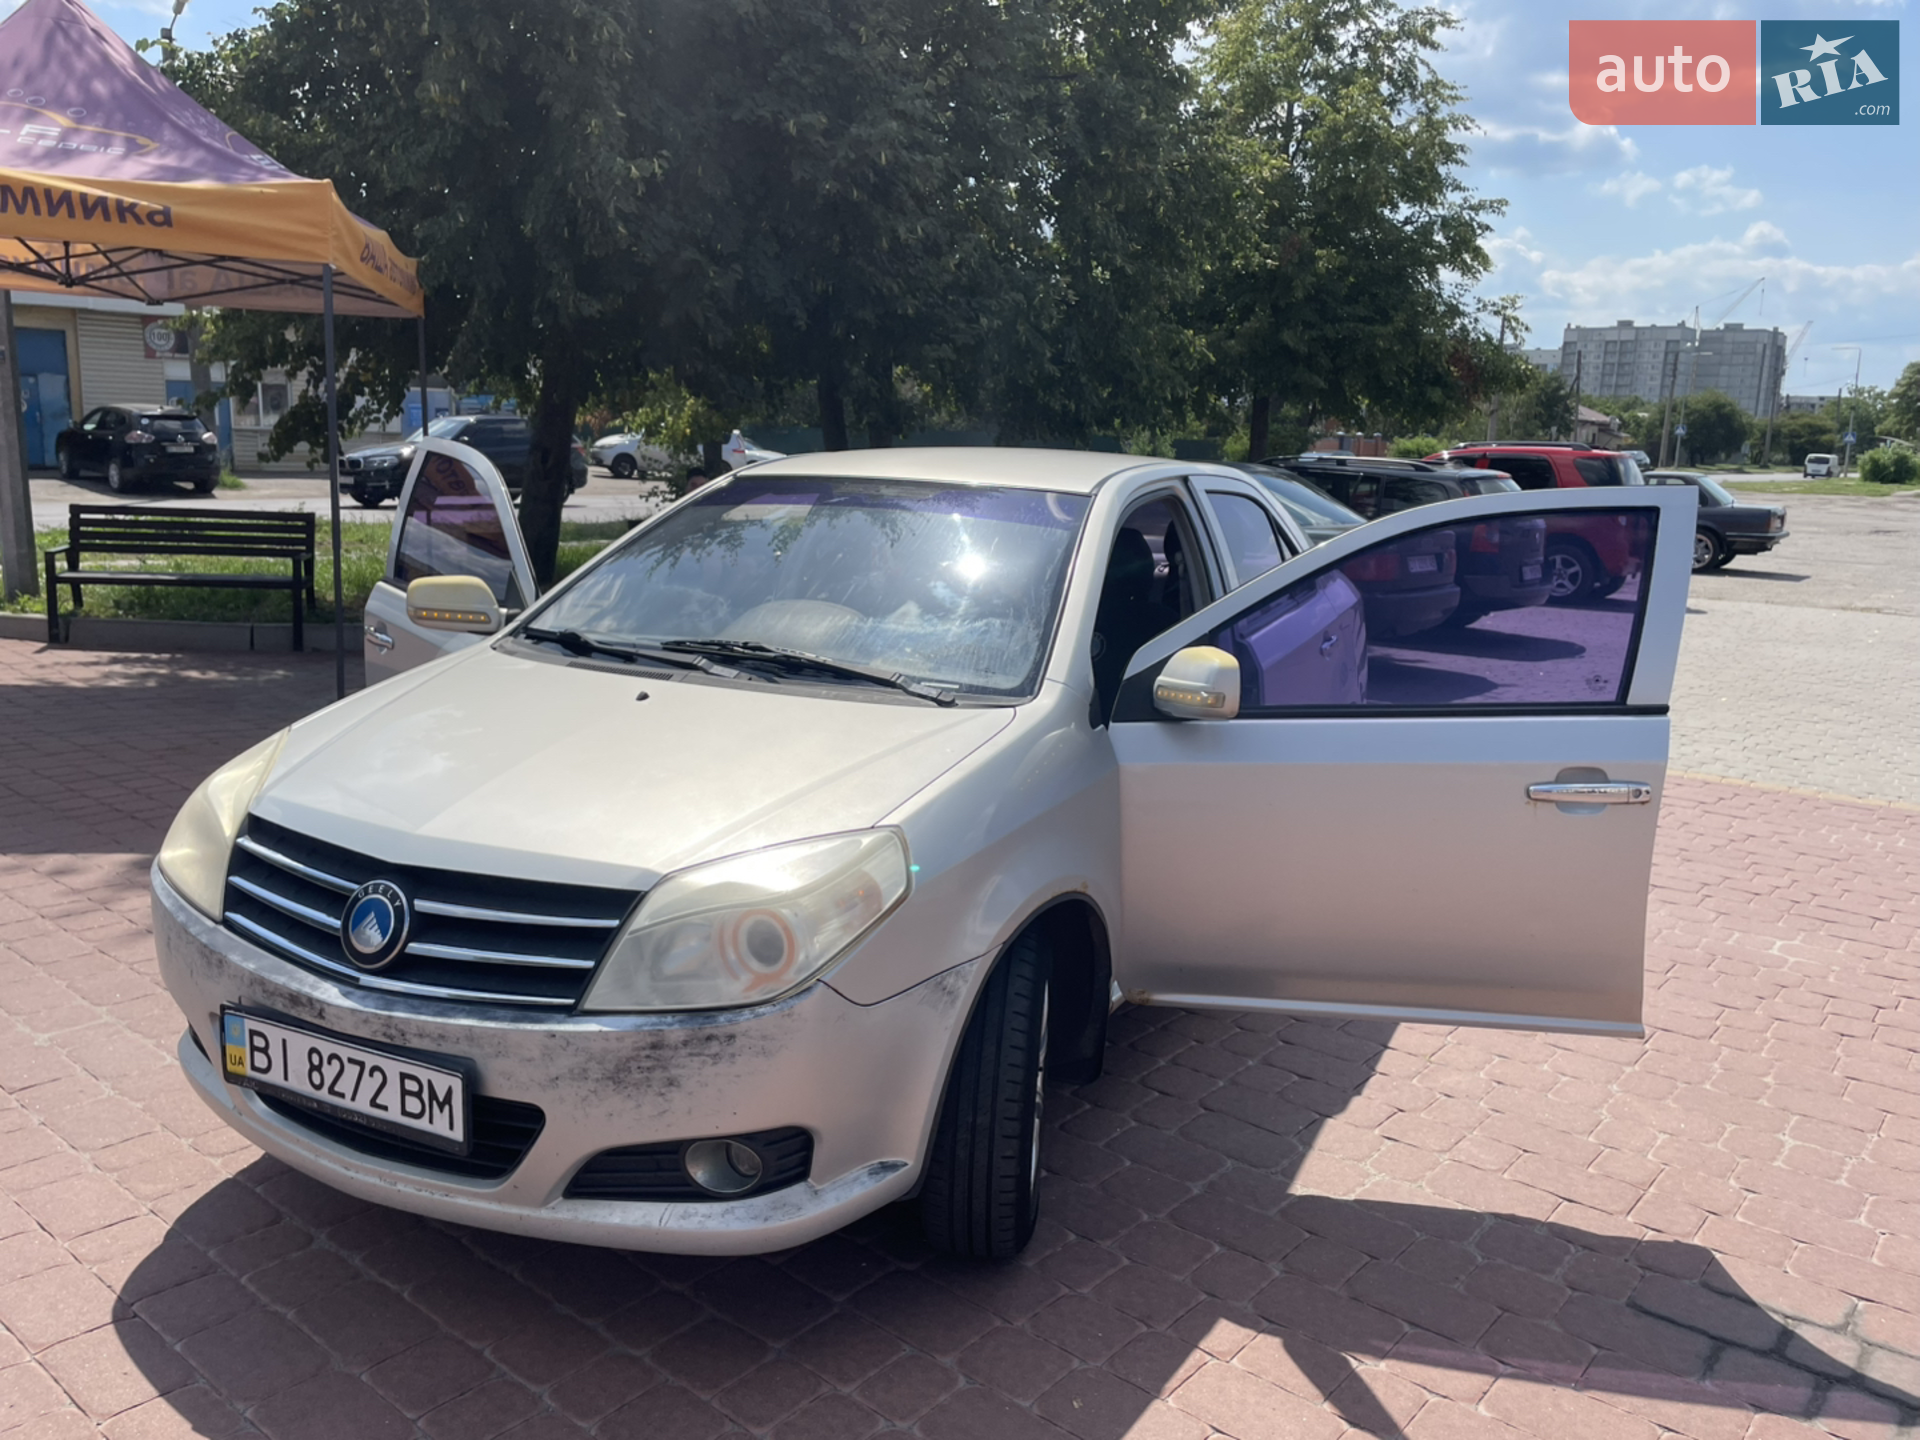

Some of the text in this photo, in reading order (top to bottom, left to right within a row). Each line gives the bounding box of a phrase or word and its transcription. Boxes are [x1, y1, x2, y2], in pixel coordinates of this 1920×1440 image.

[357, 884, 402, 907] GEELY
[229, 1052, 245, 1069] UA
[307, 1046, 389, 1112] 8272
